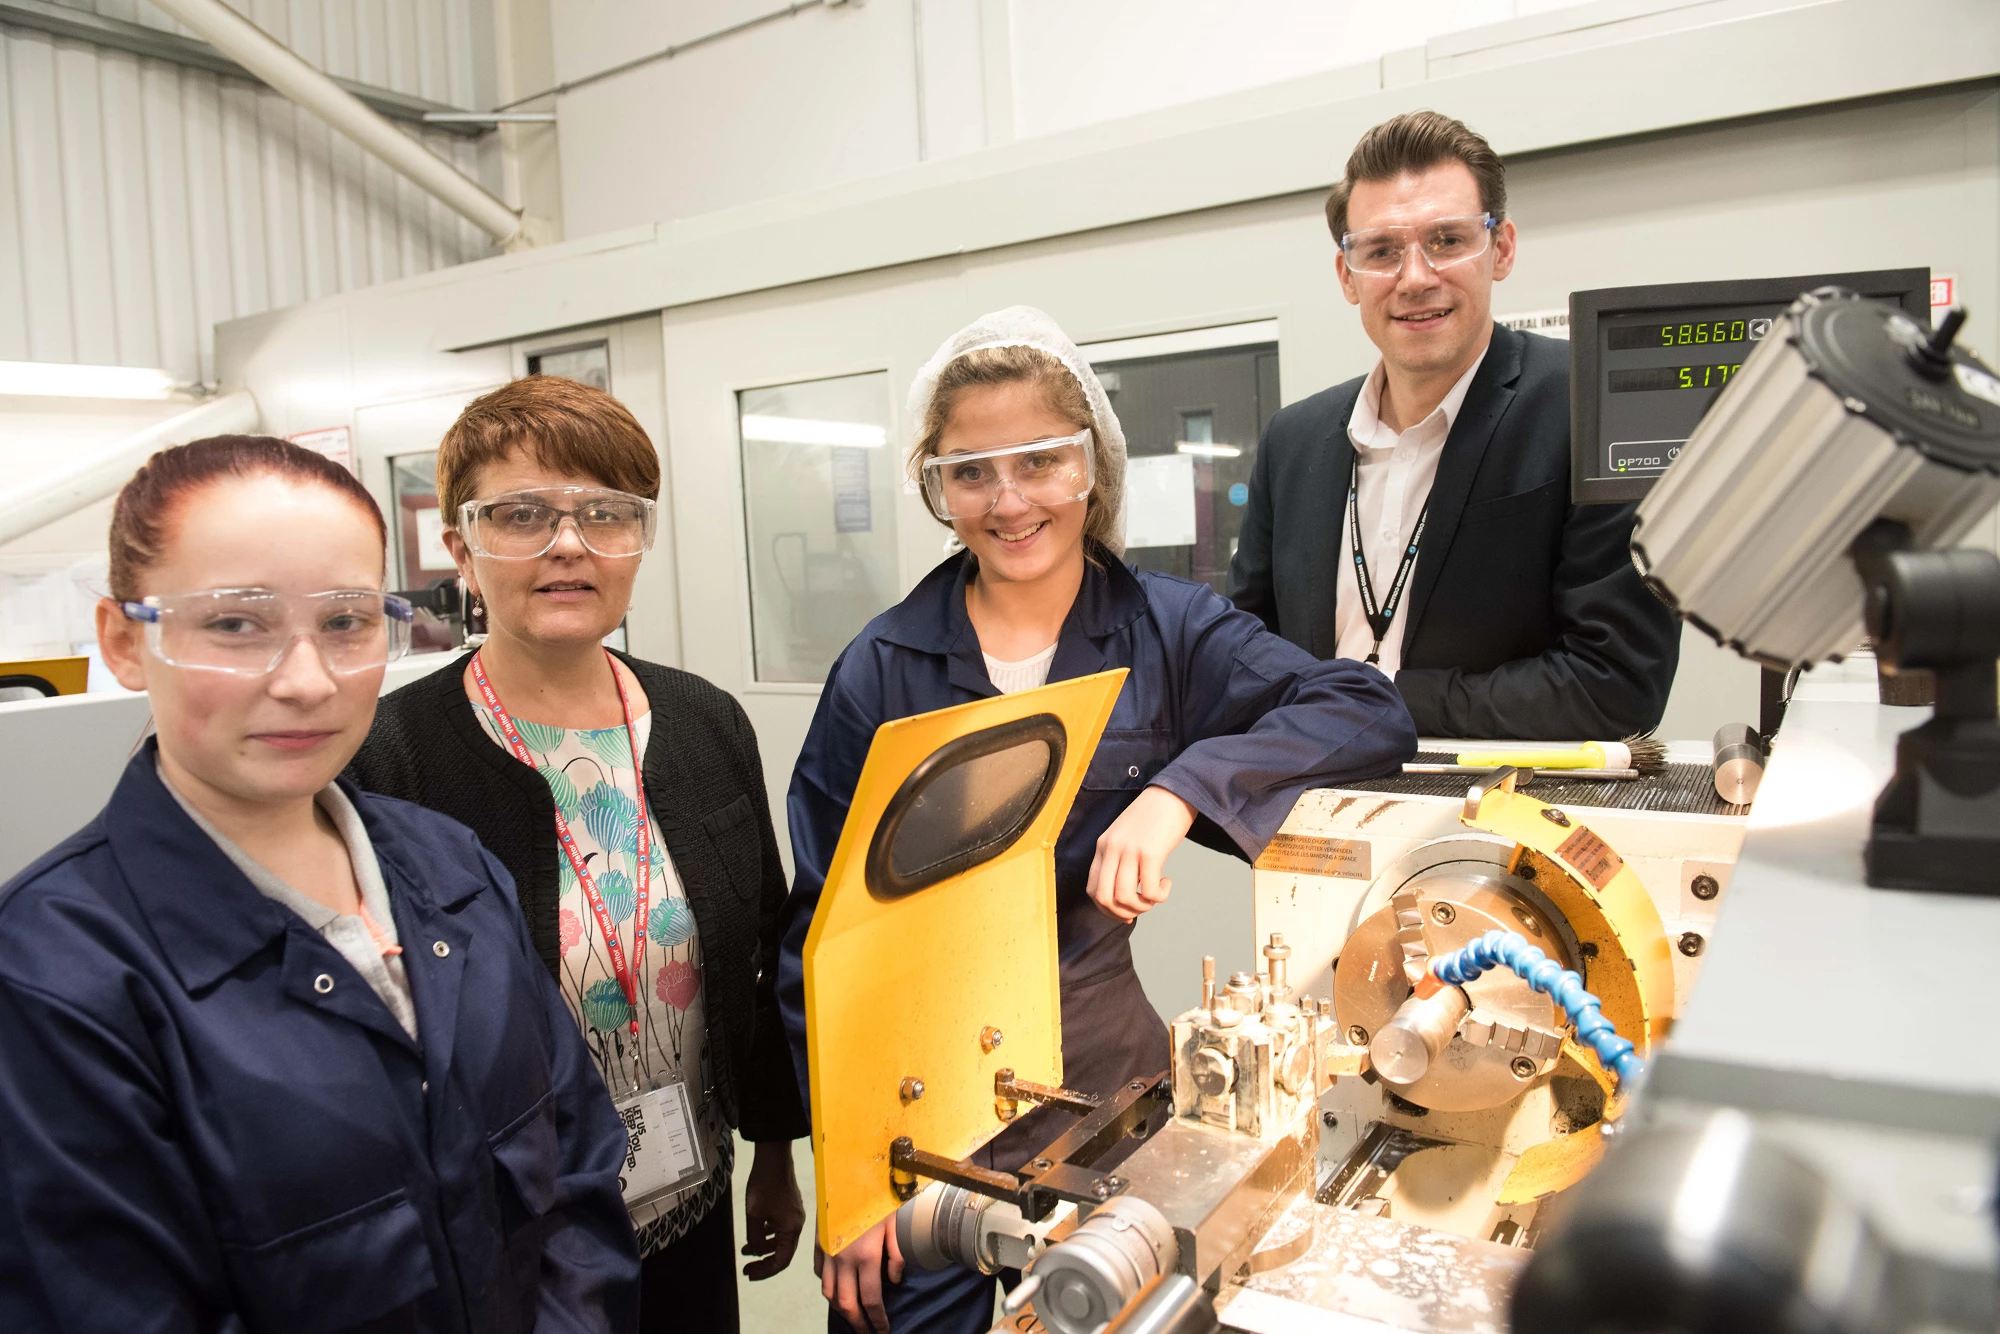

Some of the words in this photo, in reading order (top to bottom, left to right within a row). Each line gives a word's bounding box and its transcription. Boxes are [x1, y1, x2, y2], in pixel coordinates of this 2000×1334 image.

[1541, 315, 1570, 328] INFO
[1661, 320, 1745, 346] 58.660
[1617, 457, 1661, 467] DP700
[483, 686, 497, 705] Visitor
[499, 713, 515, 735] Visitor
[517, 745, 532, 766] Visitor
[569, 844, 584, 868] Visitor
[639, 864, 648, 889] Visitor
[585, 878, 600, 903] Visitor
[600, 913, 615, 938] Visitor
[638, 901, 647, 927] Visitor
[613, 949, 625, 973] Visitor
[633, 1104, 644, 1120] LET
[624, 1107, 636, 1130] KEEP
[630, 1131, 642, 1152] YOU
[636, 1121, 647, 1136] US
